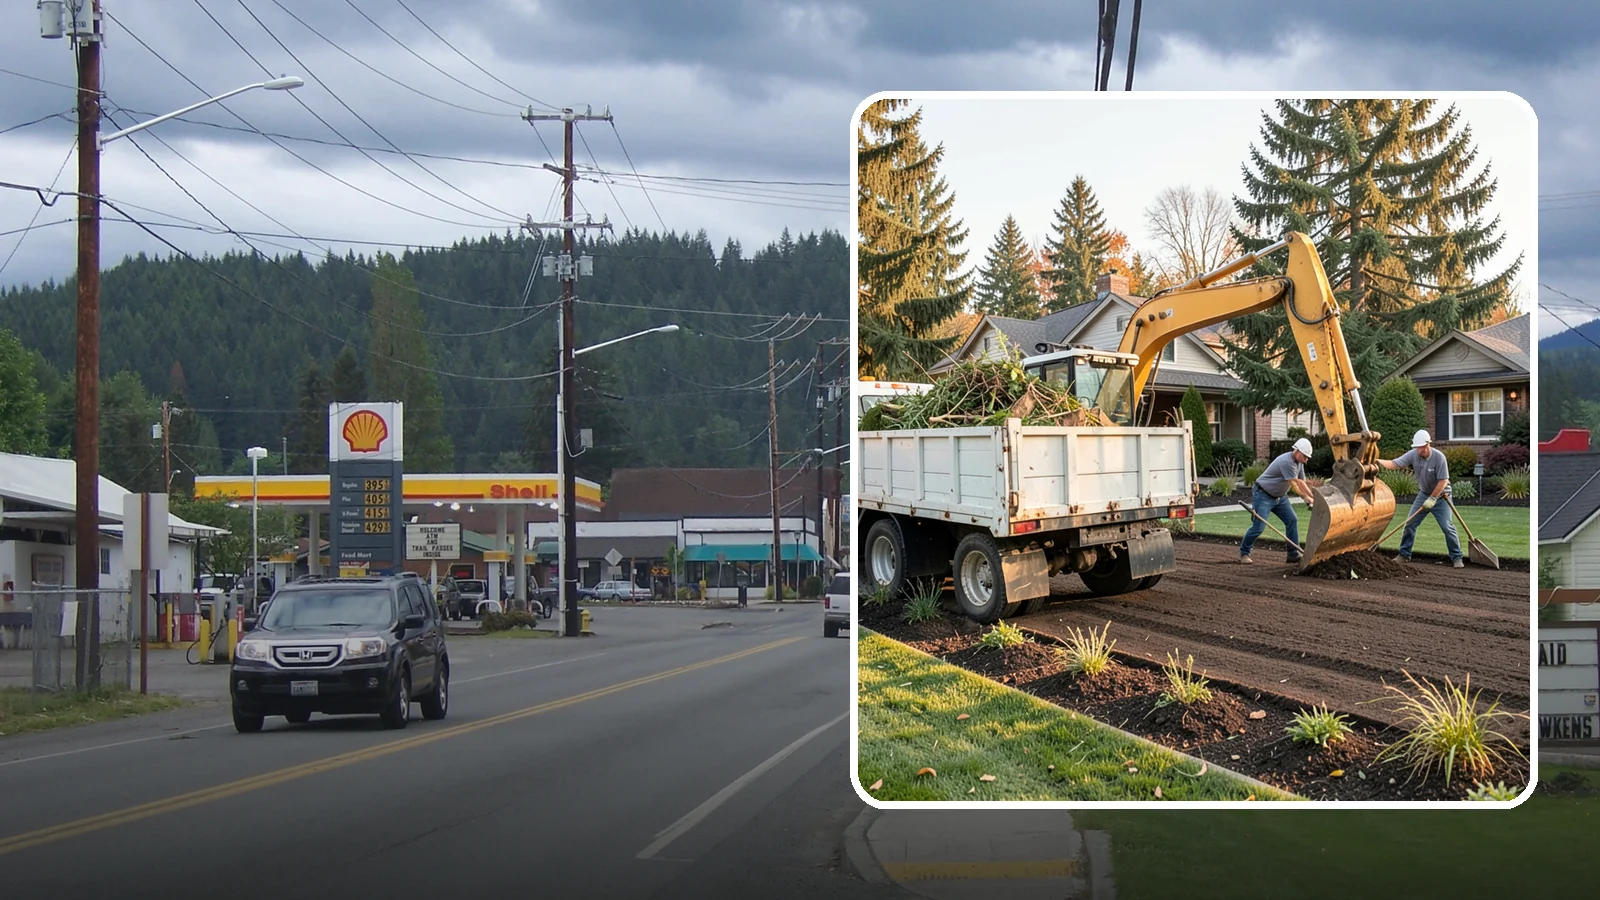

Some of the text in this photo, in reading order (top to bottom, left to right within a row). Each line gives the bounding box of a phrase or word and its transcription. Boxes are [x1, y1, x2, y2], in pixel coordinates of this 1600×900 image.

[366, 480, 383, 490] 395
[490, 484, 547, 499] Shell
[366, 494, 383, 504] 405
[366, 507, 383, 518] 415
[366, 522, 383, 533] 429
